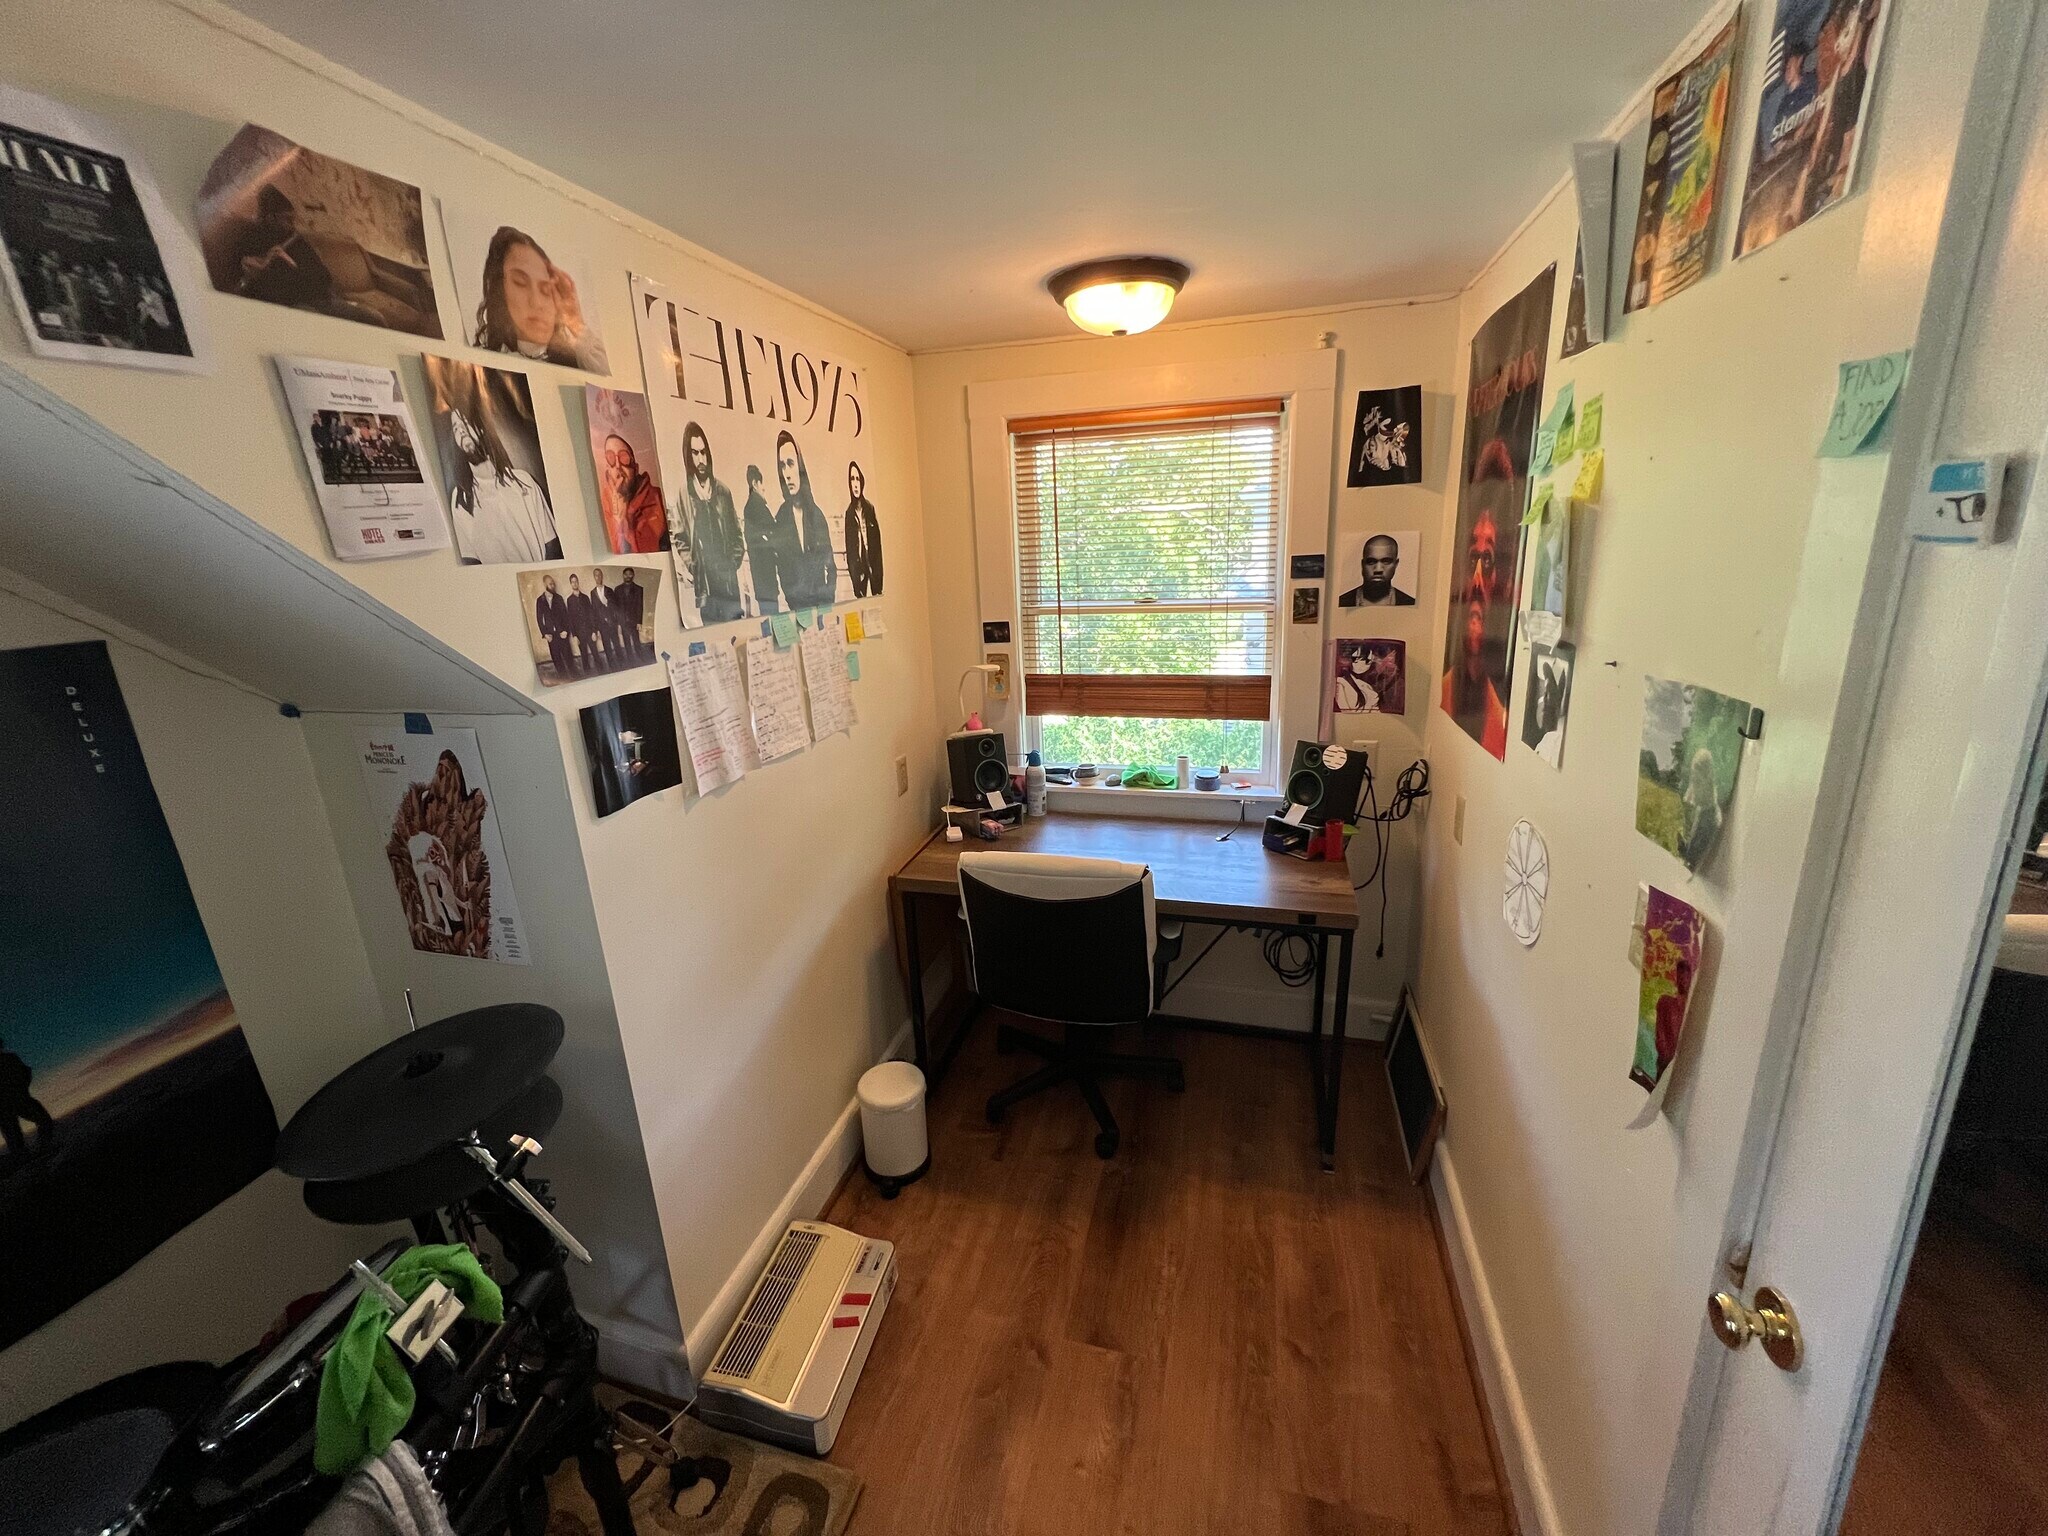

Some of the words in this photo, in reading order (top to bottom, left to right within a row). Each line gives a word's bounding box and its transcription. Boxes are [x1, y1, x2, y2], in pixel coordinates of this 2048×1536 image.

[1843, 356, 1895, 394] FIND
[64, 685, 106, 774] DELUXE
[365, 754, 406, 765] MONONOKE
